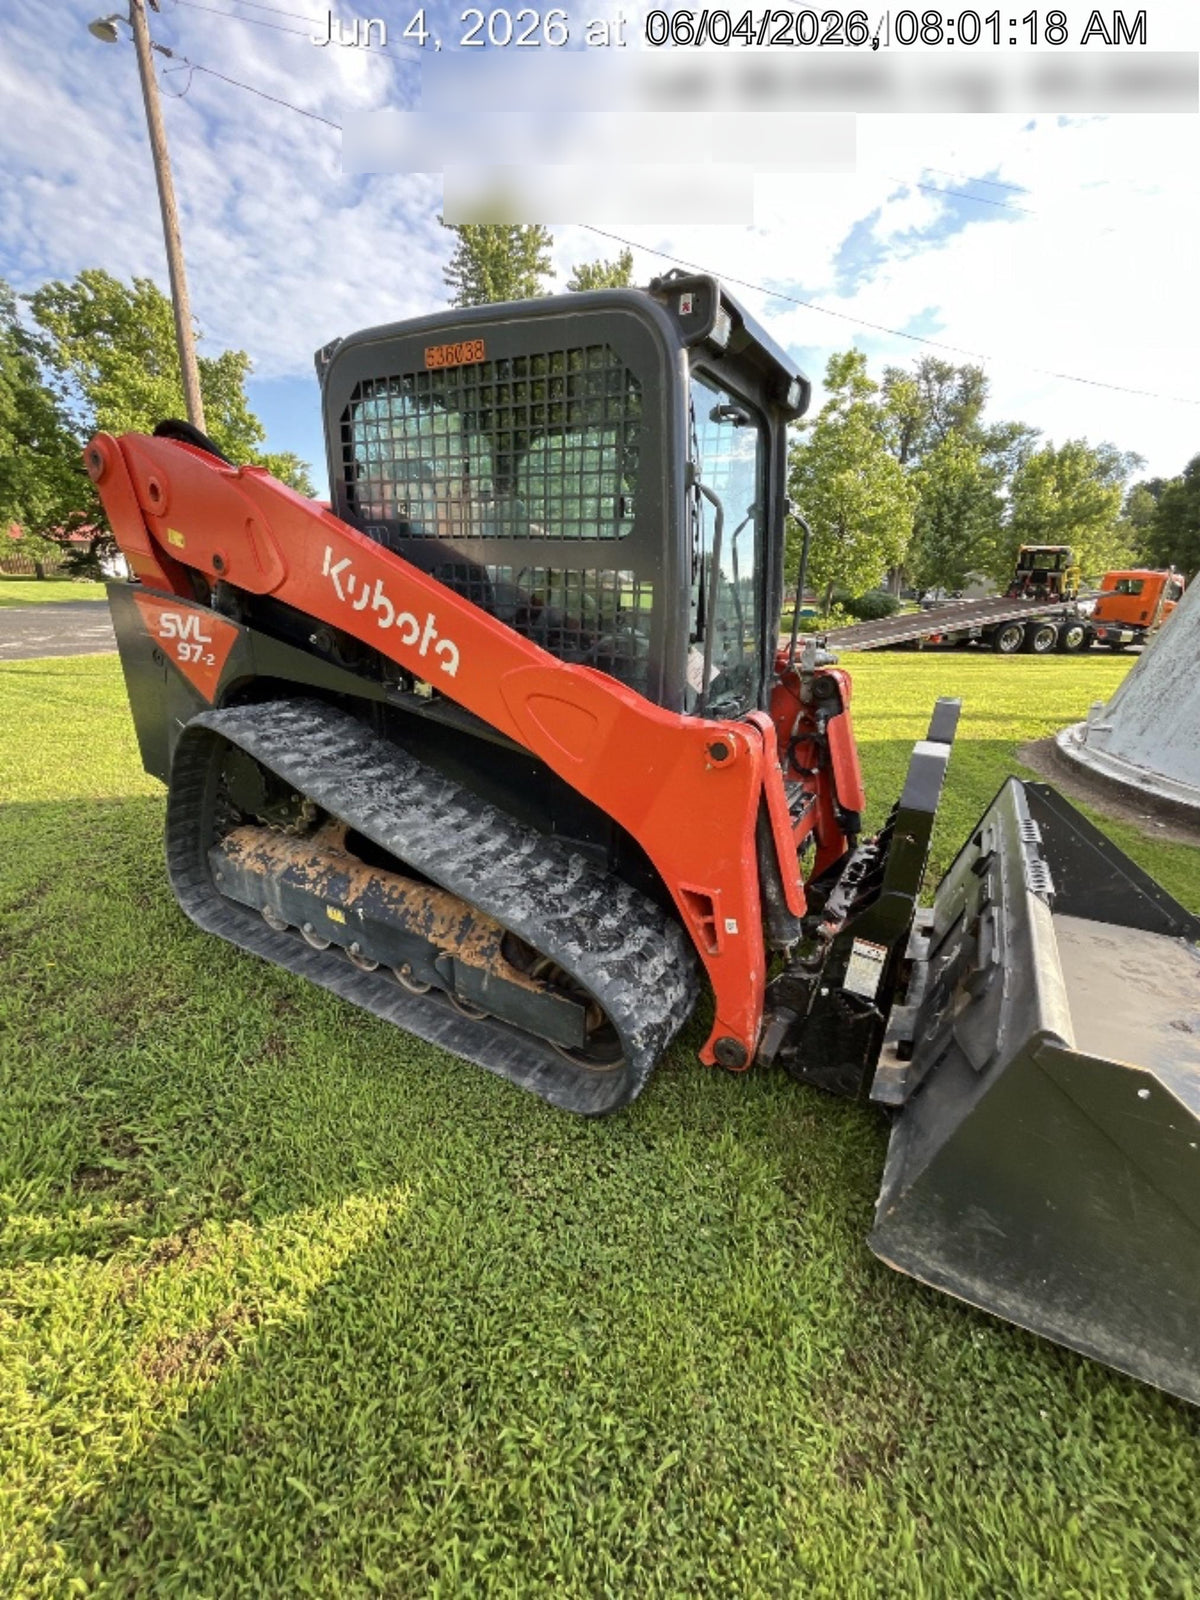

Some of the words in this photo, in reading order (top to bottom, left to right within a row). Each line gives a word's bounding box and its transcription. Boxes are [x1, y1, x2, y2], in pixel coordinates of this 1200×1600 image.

[425, 340, 485, 367] 536038
[321, 545, 460, 678] Kubota
[158, 612, 212, 643] SVL
[177, 641, 216, 666] 97-2
